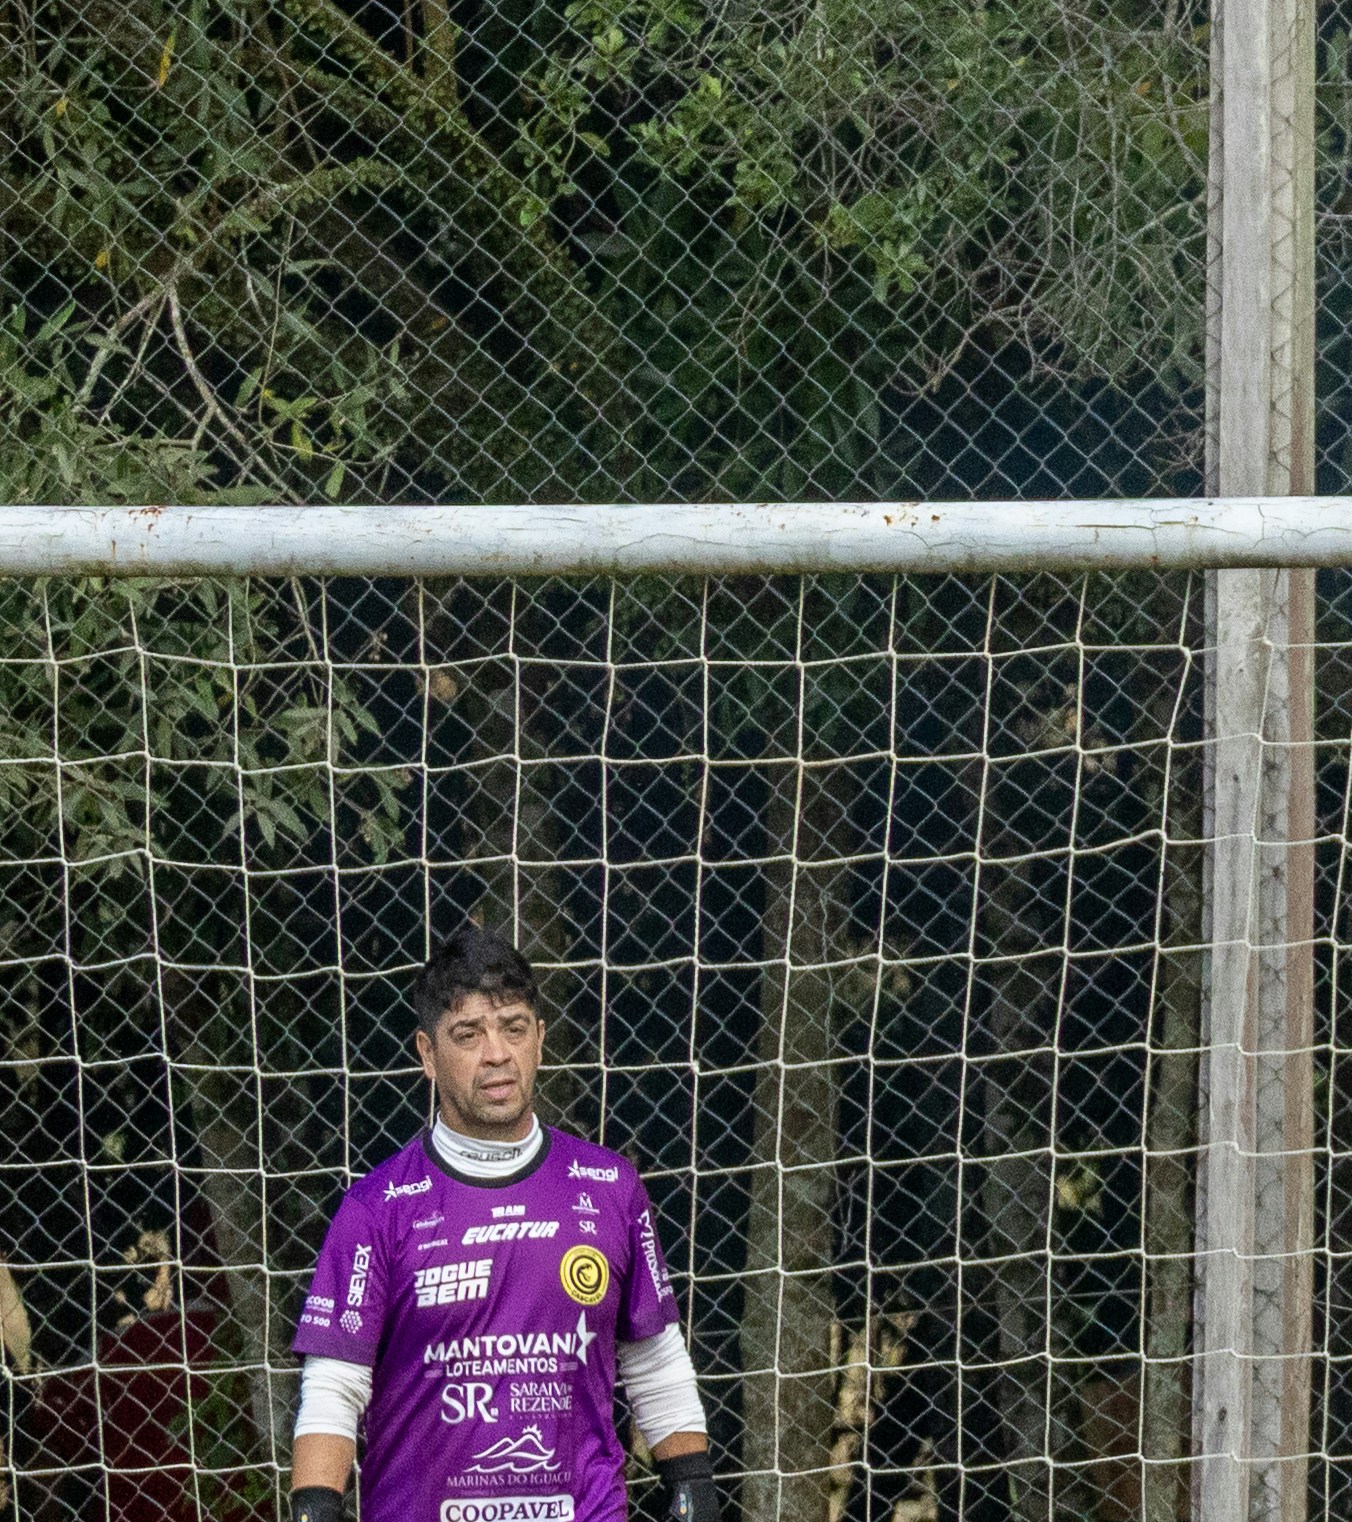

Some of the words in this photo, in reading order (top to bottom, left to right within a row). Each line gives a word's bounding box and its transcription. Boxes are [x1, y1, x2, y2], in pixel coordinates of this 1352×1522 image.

[461, 1221, 560, 1246] EUCATUR
[346, 1242, 372, 1307] SIEVEX
[414, 1258, 494, 1289] JOGUE
[414, 1277, 489, 1308] BEM
[424, 1332, 577, 1364] MANTOVANI
[446, 1357, 558, 1377] LOTEAMENTOS
[446, 1475, 505, 1488] MARINAS
[508, 1473, 528, 1486] DO
[445, 1499, 570, 1522] COOPAVEL
